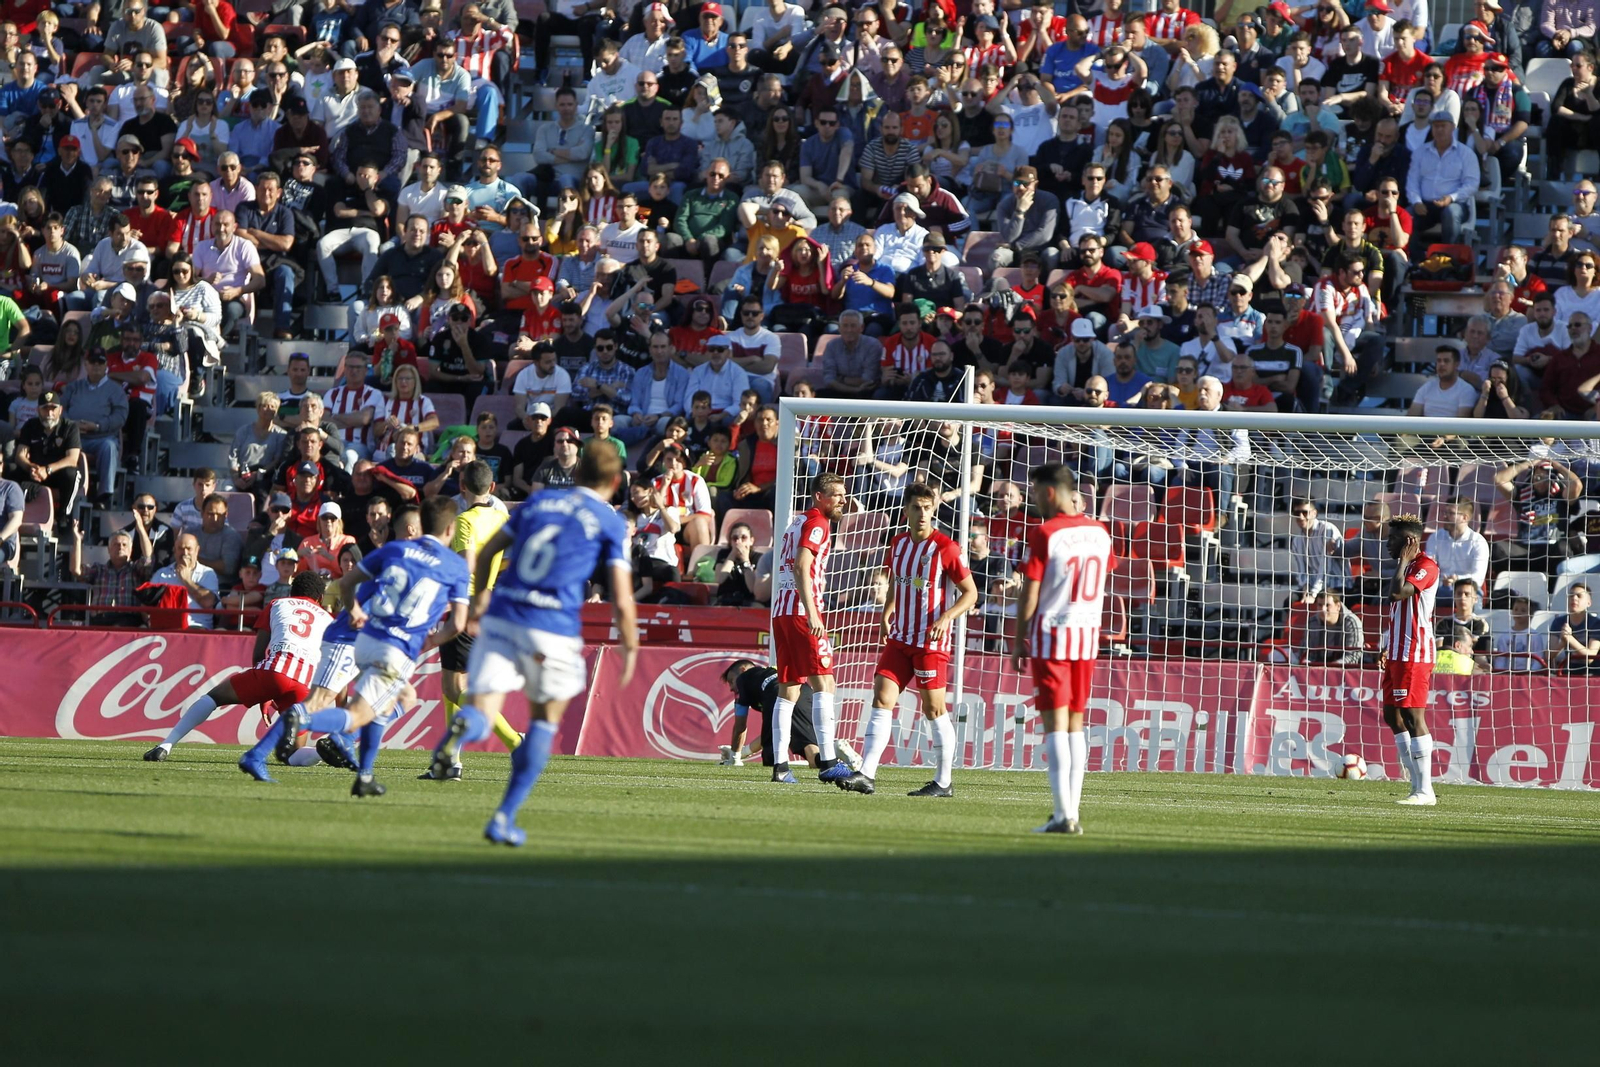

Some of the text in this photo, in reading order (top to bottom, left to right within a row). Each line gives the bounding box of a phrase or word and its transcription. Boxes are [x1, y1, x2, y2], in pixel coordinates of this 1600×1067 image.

[517, 524, 561, 584] 6
[372, 565, 441, 628] 34
[1066, 555, 1101, 603] 10
[287, 600, 325, 617] OWONA
[289, 608, 315, 639] 3
[1273, 675, 1491, 707] Autores
[1431, 715, 1598, 790] del
